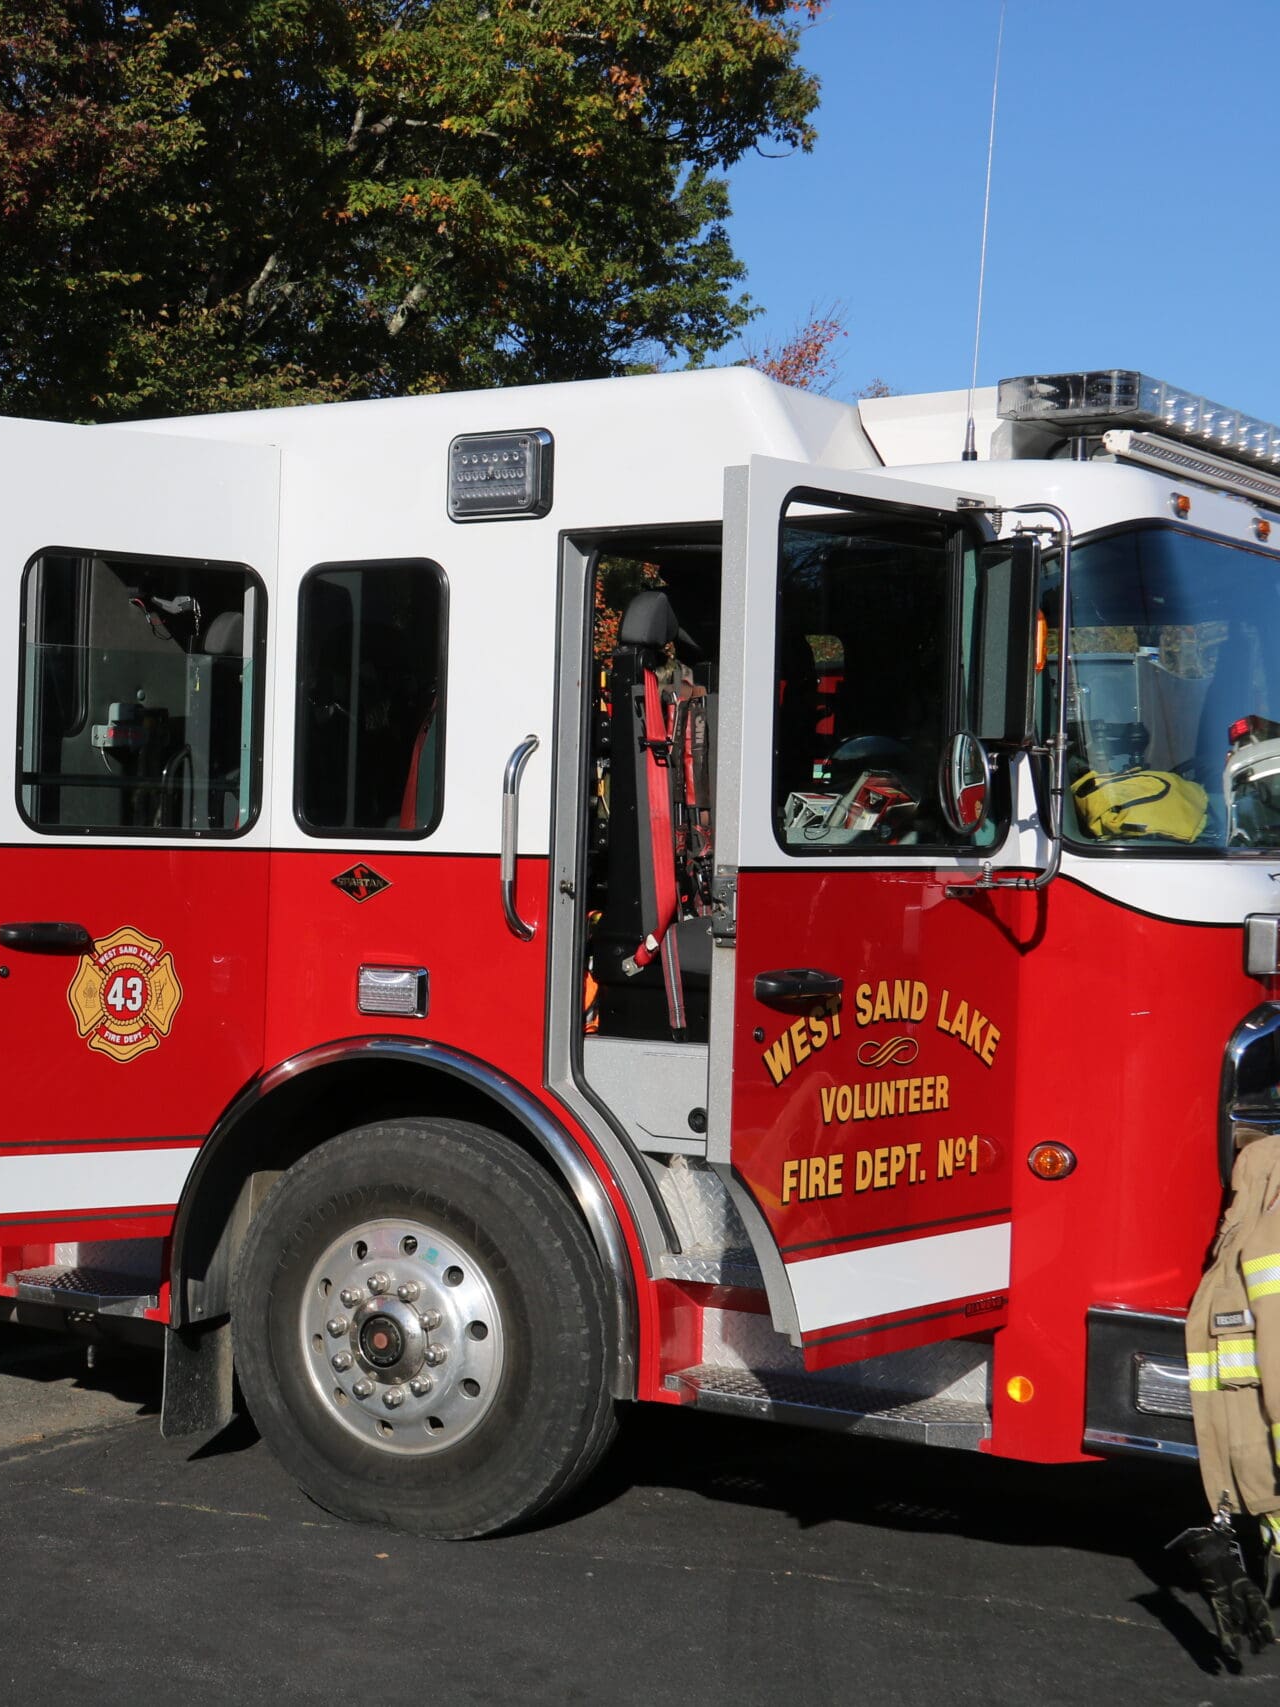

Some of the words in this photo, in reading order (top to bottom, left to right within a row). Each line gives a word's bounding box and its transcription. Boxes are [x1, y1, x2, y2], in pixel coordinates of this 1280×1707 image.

[98, 949, 117, 965] WEST
[119, 945, 138, 955] SAND
[139, 950, 157, 966] LAKE
[107, 977, 143, 1011] 43
[104, 1031, 121, 1043] FIRE
[123, 1031, 146, 1044] DEPT.
[763, 993, 842, 1085] WEST
[856, 980, 928, 1026] SAND
[937, 990, 1001, 1066] LAKE
[820, 1075, 950, 1124] VOLUNTEER
[782, 1154, 844, 1204] FIRE
[855, 1143, 926, 1192] DEPT.
